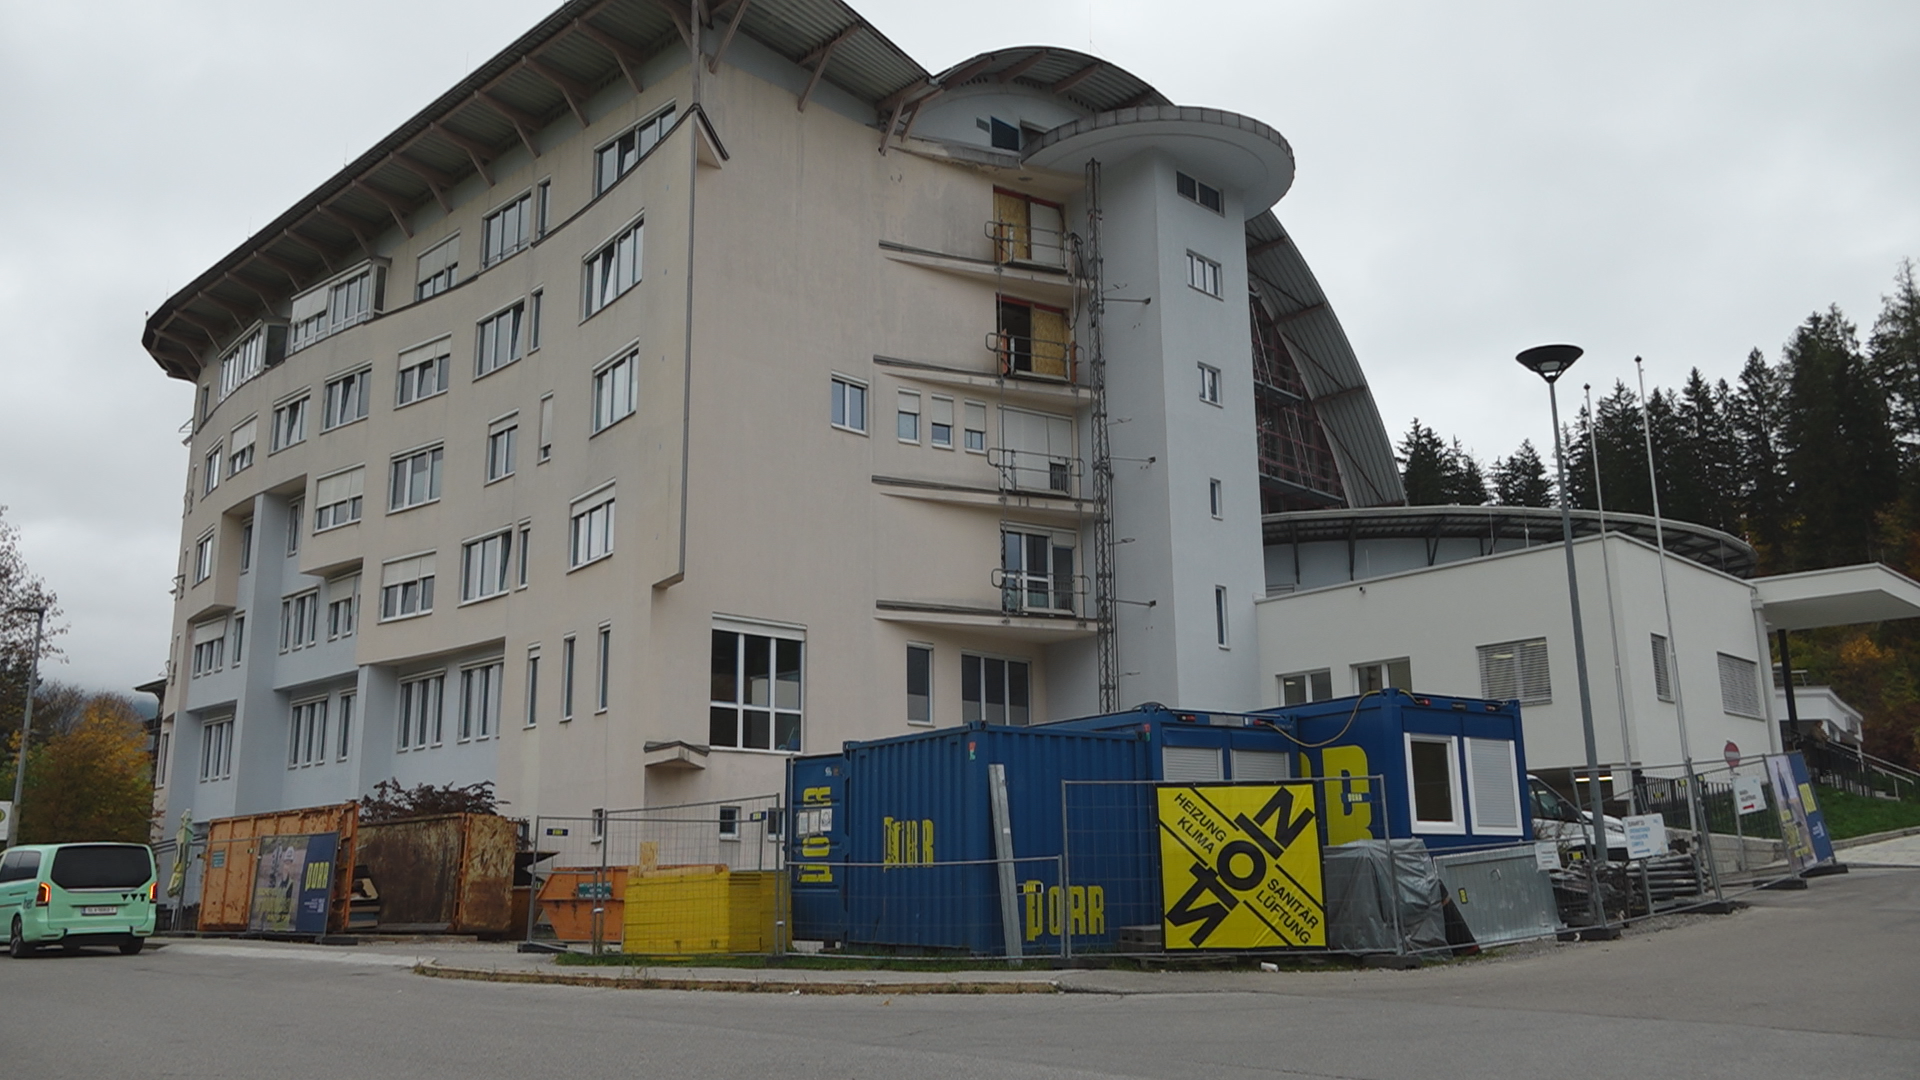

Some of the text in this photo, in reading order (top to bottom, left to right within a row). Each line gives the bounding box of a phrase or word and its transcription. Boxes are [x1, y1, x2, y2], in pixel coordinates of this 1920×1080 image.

[1174, 793, 1226, 842] HEIZUNG
[1177, 816, 1216, 855] KLIMA
[1026, 880, 1105, 941] PORR
[1256, 890, 1311, 944] LÜFTUNG
[1267, 879, 1319, 929] SANITÄR
